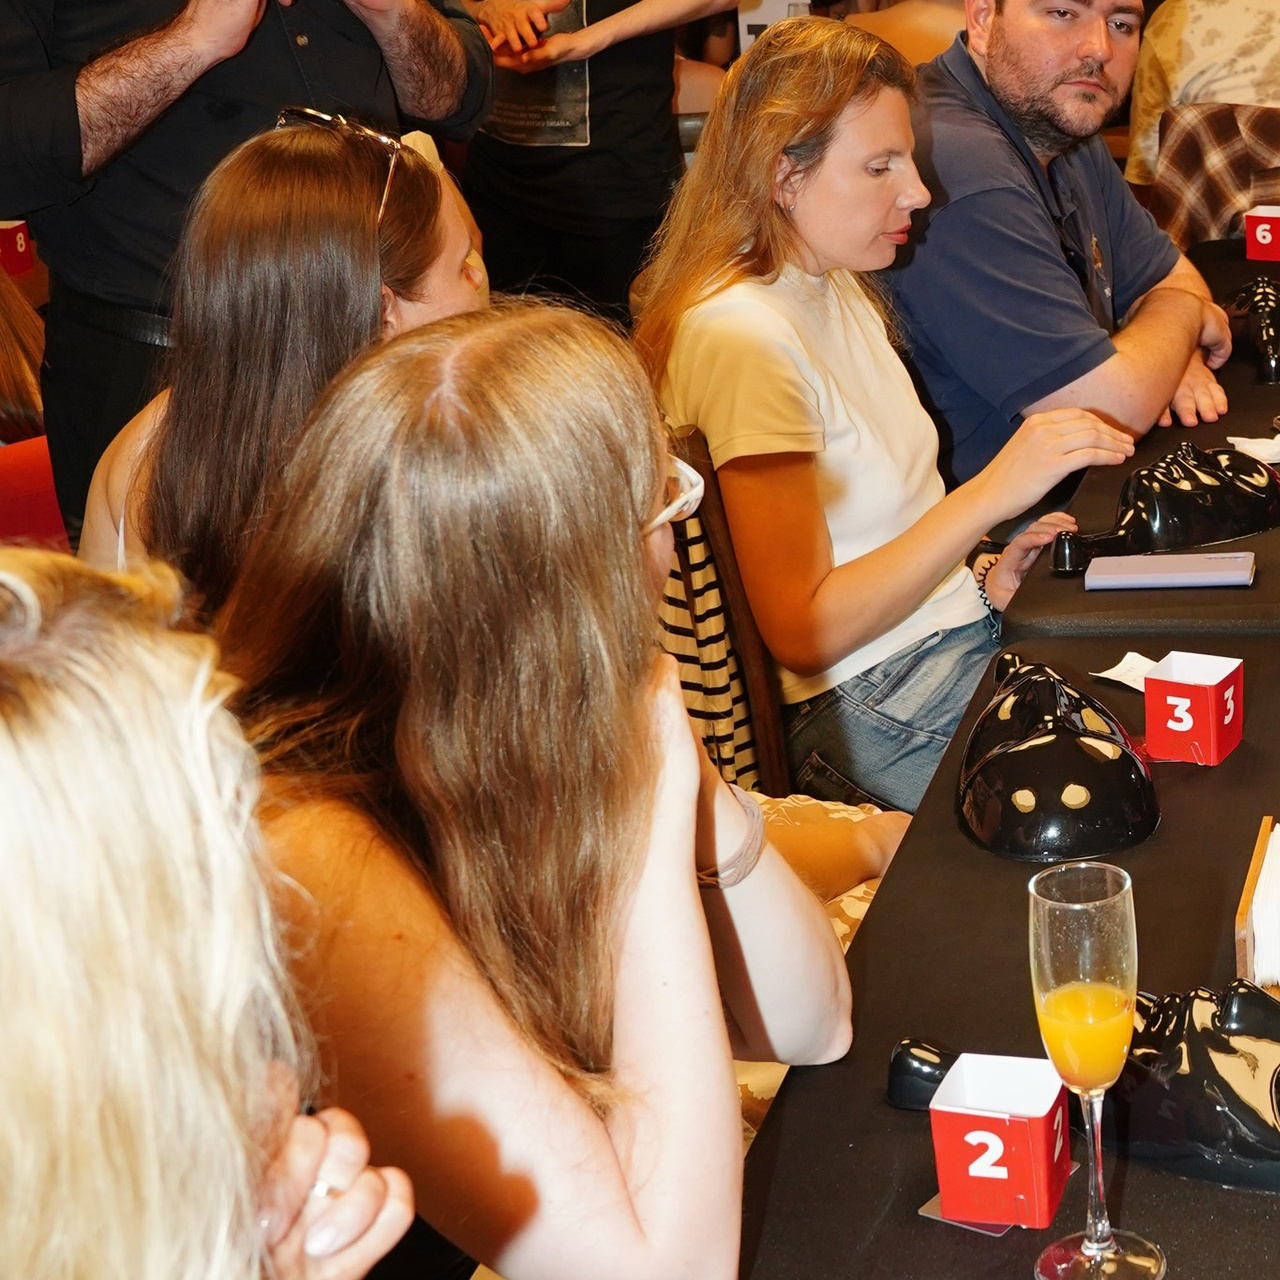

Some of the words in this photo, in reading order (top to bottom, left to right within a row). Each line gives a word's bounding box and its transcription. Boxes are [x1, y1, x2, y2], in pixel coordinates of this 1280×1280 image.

[16, 232, 26, 252] 8
[1256, 223, 1272, 245] 6
[1166, 695, 1194, 732] 3
[1224, 685, 1234, 725] 3
[1053, 1105, 1063, 1164] 2
[963, 1130, 1008, 1179] 2
